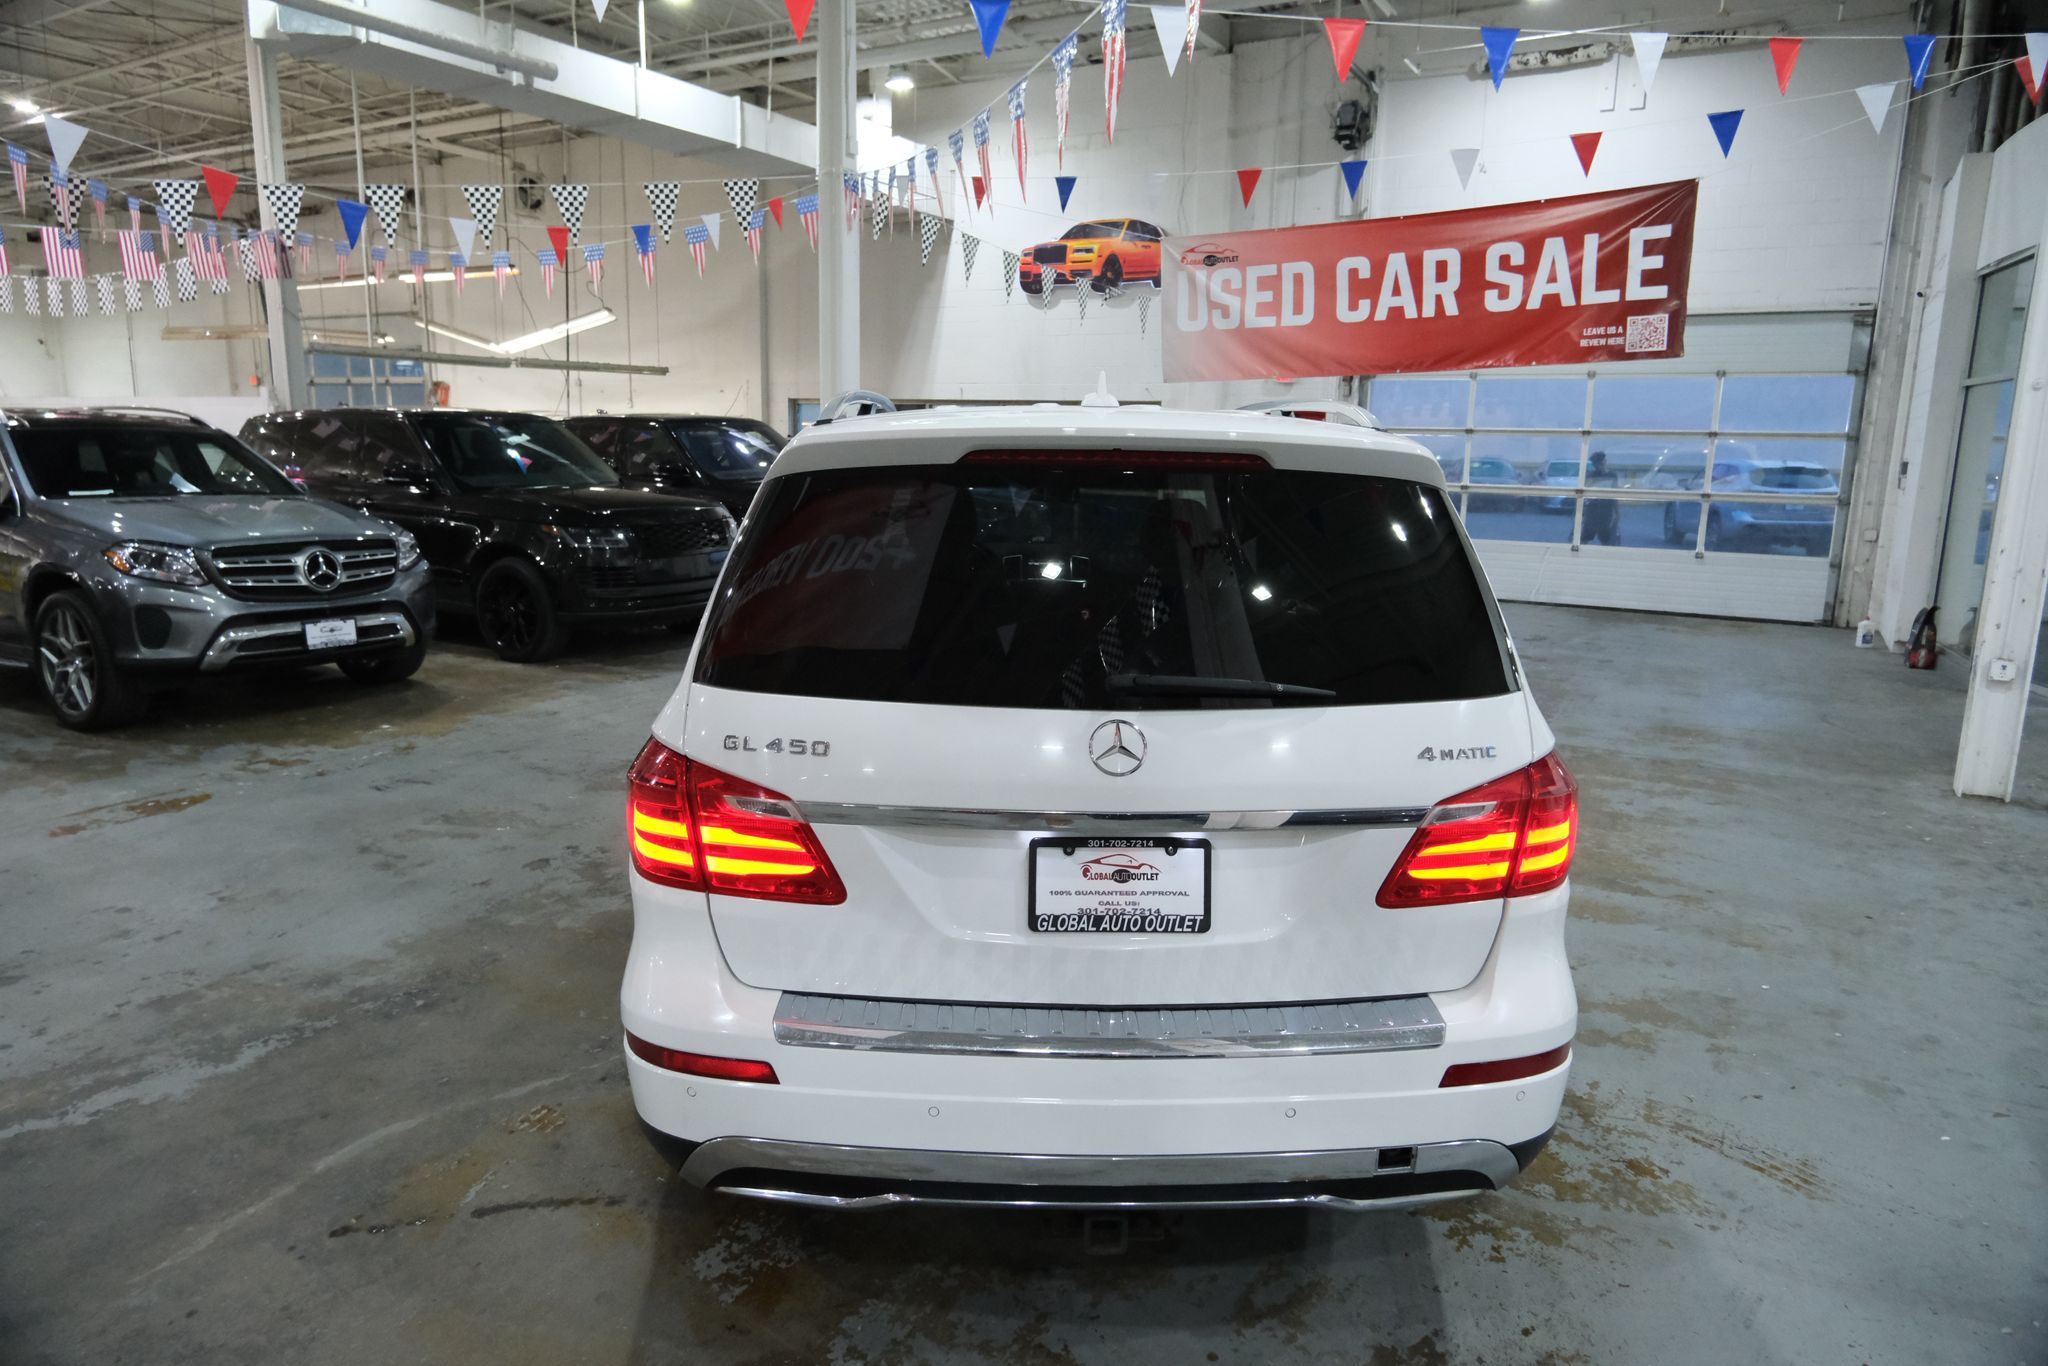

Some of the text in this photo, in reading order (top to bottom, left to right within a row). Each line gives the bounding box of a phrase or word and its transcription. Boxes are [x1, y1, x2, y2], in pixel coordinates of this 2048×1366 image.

[1176, 223, 1673, 332] USED CAR SALE
[1583, 325, 1624, 336] LEAVE US A
[1579, 336, 1626, 347] REVIEW HERE
[723, 734, 831, 757] GL 450
[1077, 907, 1161, 915] 301-702-7214
[1037, 914, 1204, 932] GLOBAL AUTO OUTLET
